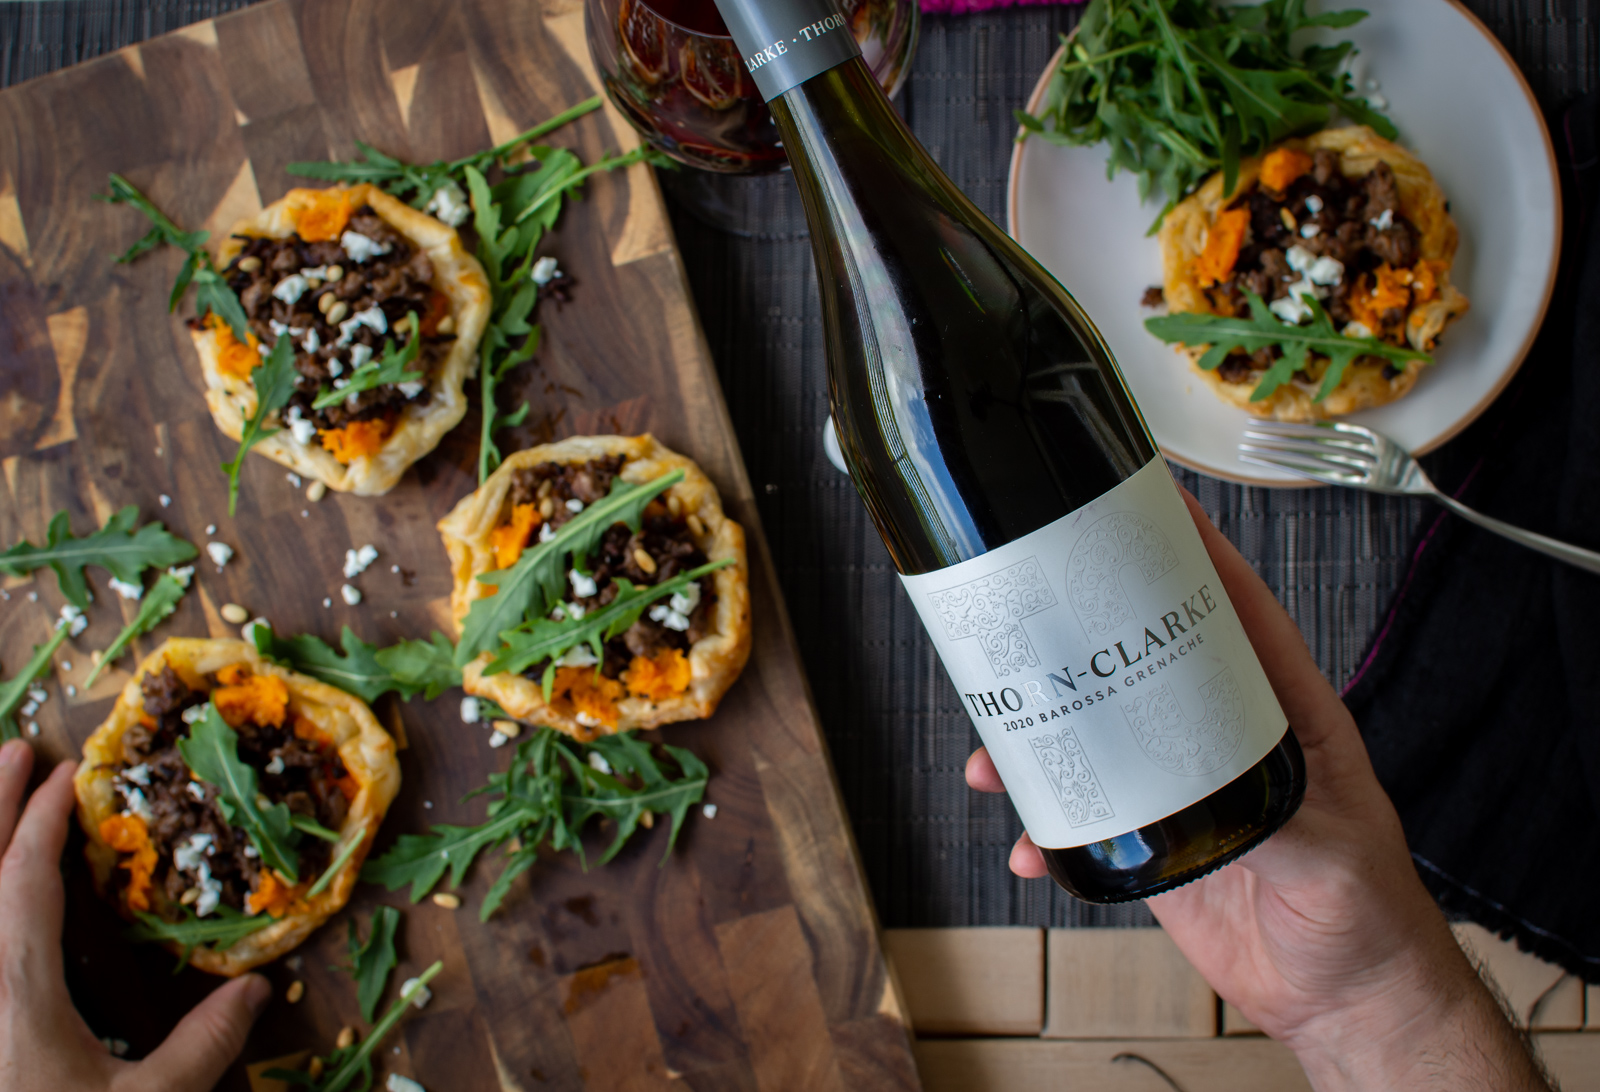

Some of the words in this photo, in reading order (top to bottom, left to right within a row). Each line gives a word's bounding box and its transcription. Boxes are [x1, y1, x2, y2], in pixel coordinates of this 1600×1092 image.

[964, 583, 1217, 717] THORN-CLARKE
[1003, 716, 1034, 732] 2020
[1038, 685, 1118, 723] BAROSSA
[1123, 633, 1204, 687] GRENACHE
